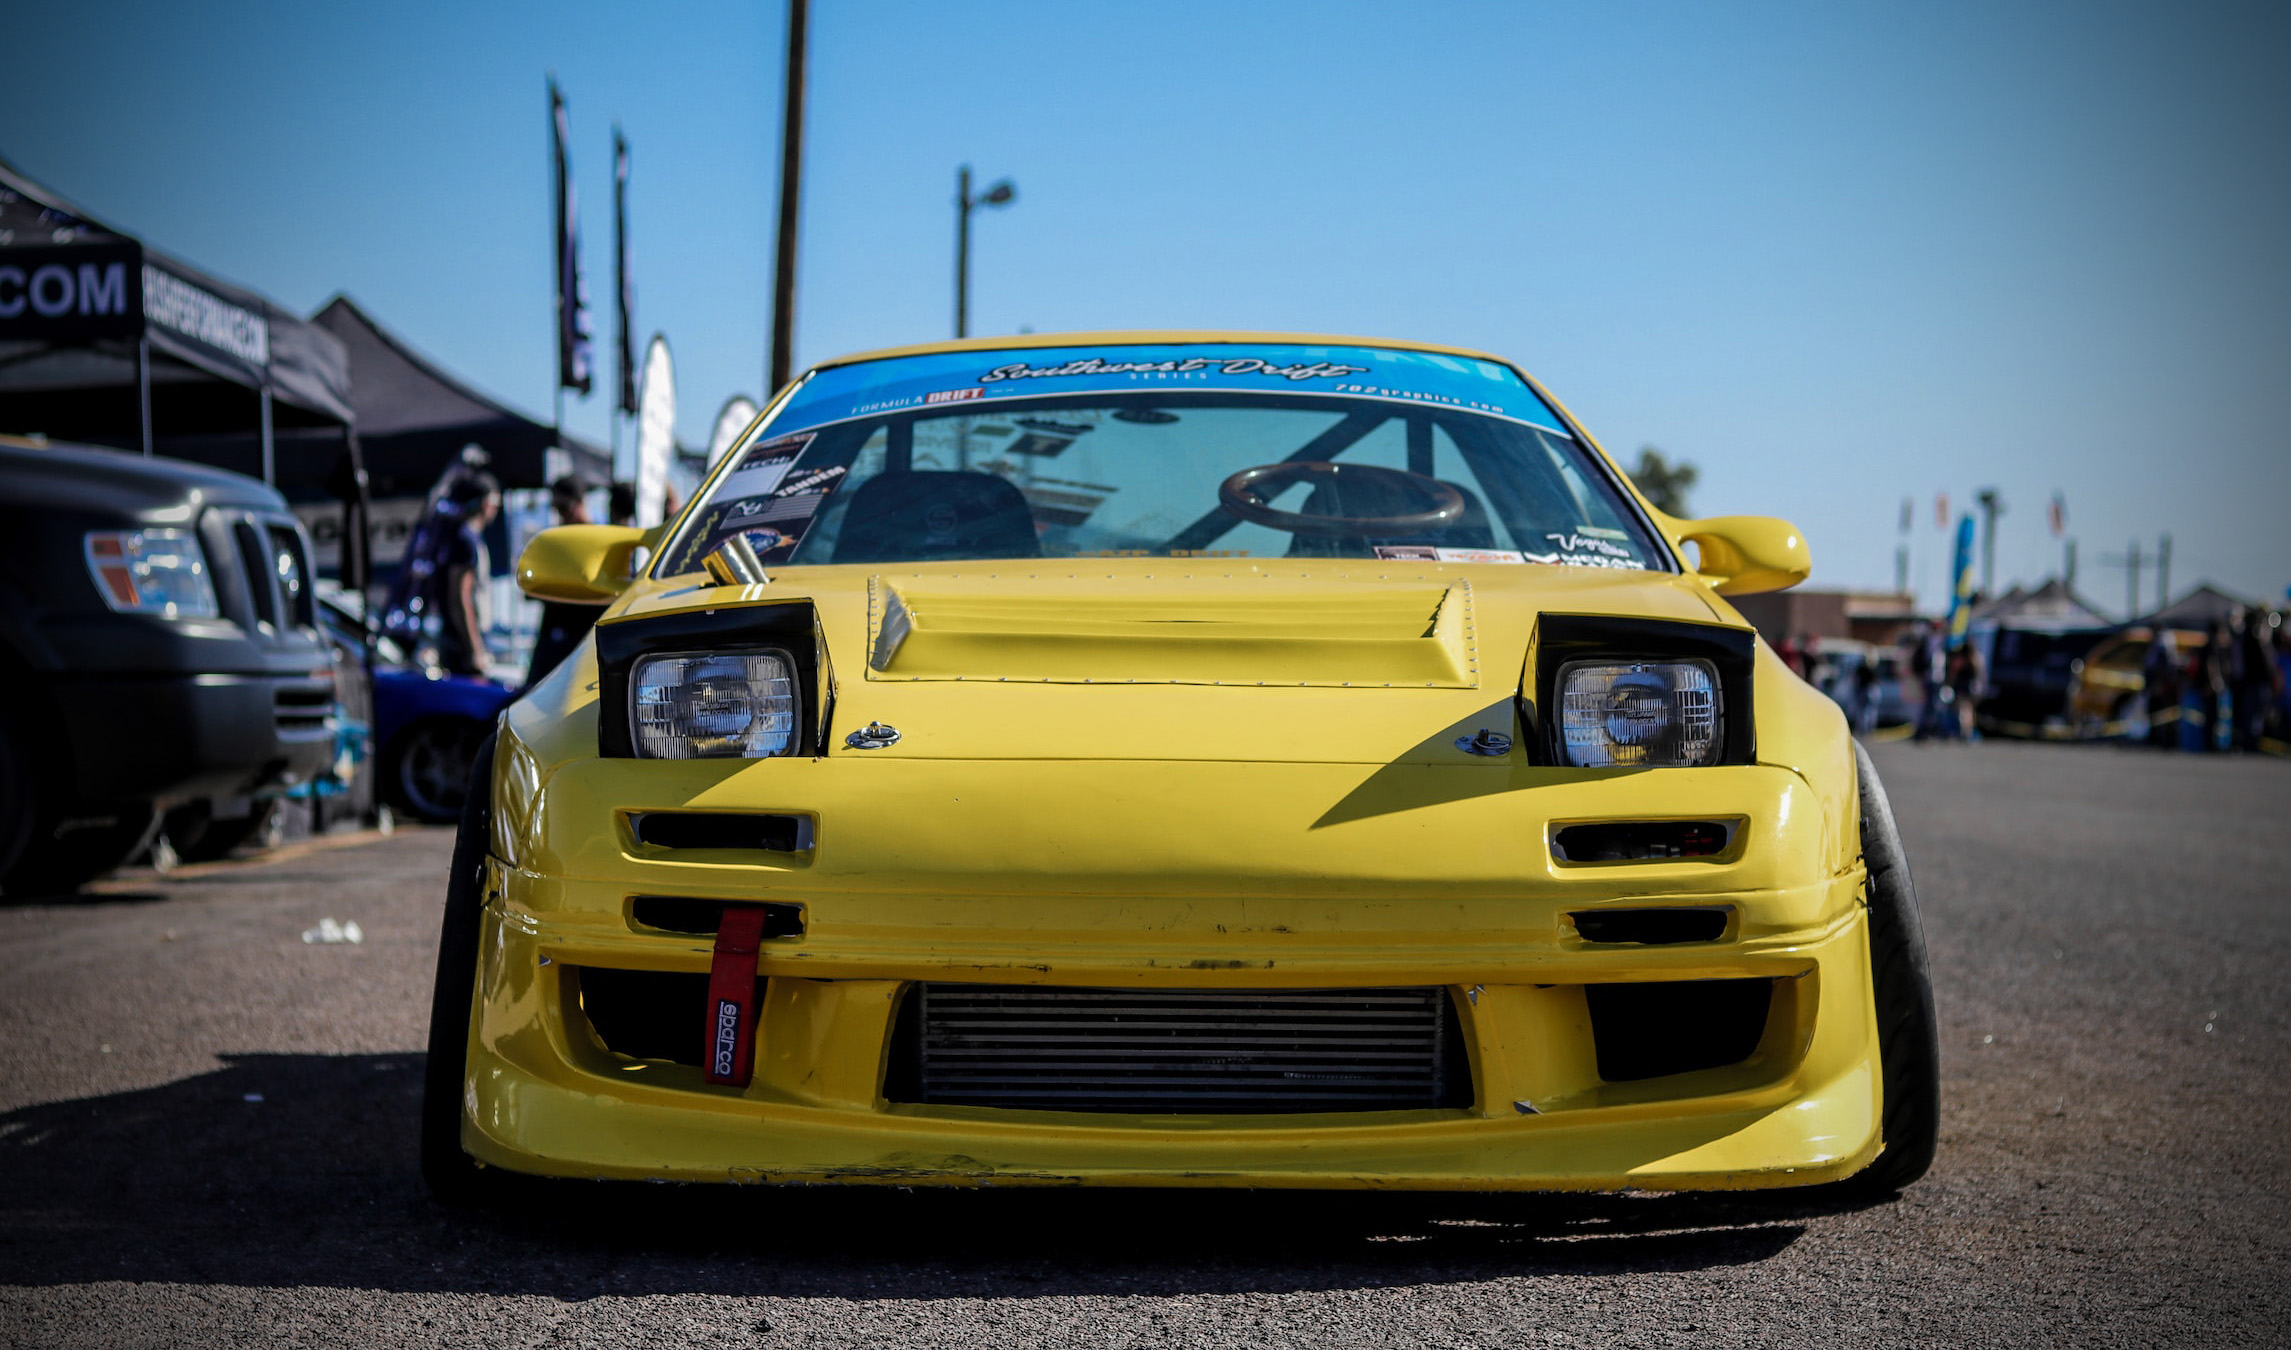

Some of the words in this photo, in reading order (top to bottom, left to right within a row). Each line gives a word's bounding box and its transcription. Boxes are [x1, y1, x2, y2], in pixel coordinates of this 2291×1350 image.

[978, 358, 1221, 383] Southwest
[1221, 357, 1370, 381] Drift
[1129, 372, 1207, 380] SERIES
[851, 396, 923, 415] FORMULA
[926, 388, 985, 404] DRIFT
[775, 465, 846, 497] TANDEM
